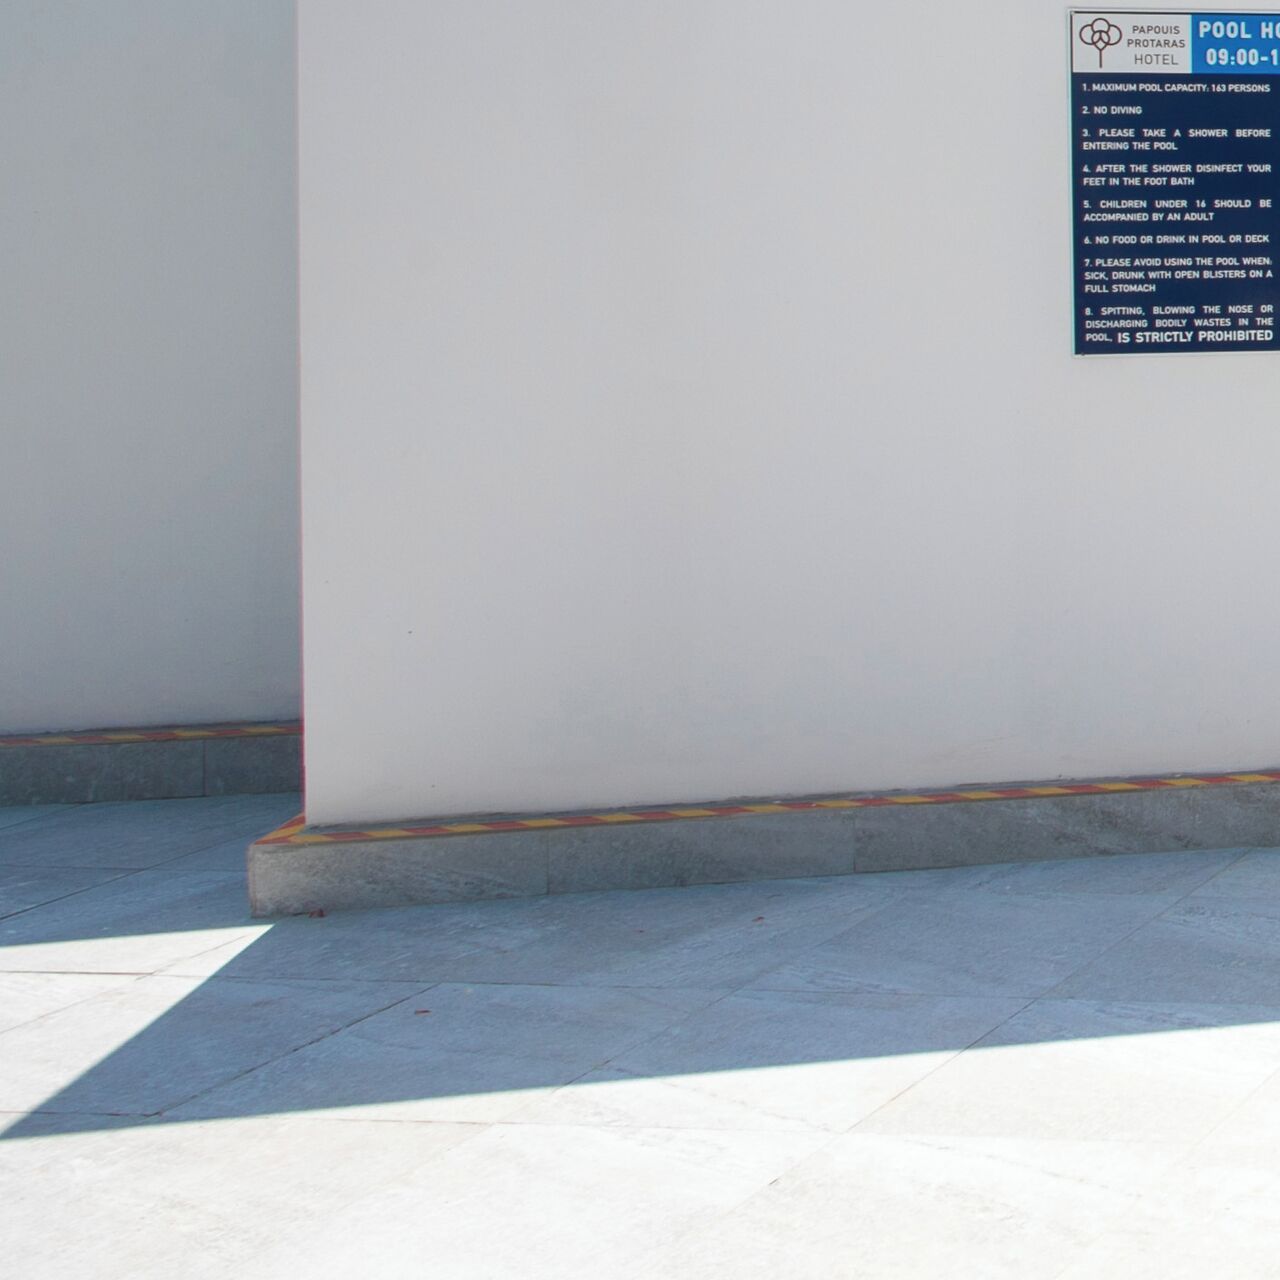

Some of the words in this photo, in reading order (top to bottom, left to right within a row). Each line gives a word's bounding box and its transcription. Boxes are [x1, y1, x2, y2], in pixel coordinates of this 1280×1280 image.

[1132, 25, 1180, 35] PAPOUIS
[1199, 21, 1252, 38] POOL
[1127, 39, 1185, 48] PROTARAS
[1134, 54, 1178, 65] HOTEL
[1083, 83, 1089, 92] 1.
[1092, 83, 1136, 92] MAXIMUM
[1139, 84, 1162, 92] POOL
[1212, 84, 1226, 92] 163
[1228, 84, 1270, 92] PERSONS
[1082, 106, 1090, 114] 2.
[1094, 106, 1108, 114] NO
[1111, 106, 1142, 114] DIVING
[1083, 129, 1090, 137] 3.
[1099, 129, 1135, 137] PLEASE
[1143, 129, 1166, 137] TAKE
[1174, 129, 1181, 137] A
[1189, 129, 1228, 137] SHOWER
[1236, 129, 1271, 137] BEFORE
[1083, 141, 1129, 150] ENTERING
[1133, 141, 1150, 150] THE
[1154, 141, 1177, 150] POOL
[1083, 164, 1091, 173] 4.
[1096, 164, 1125, 173] AFTER
[1130, 164, 1148, 173] THE
[1153, 164, 1191, 173] SHOWER
[1197, 164, 1243, 173] DISINFECT
[1247, 164, 1271, 173] YOUR
[1083, 177, 1106, 186] FEET
[1110, 177, 1119, 186] IN
[1123, 177, 1141, 186] THE
[1144, 177, 1167, 186] FOOT
[1171, 177, 1194, 186] BATH
[1084, 200, 1091, 208] 5.
[1100, 200, 1146, 208] CHILDREN
[1155, 200, 1187, 208] UNDER
[1196, 199, 1206, 208] 16
[1214, 199, 1251, 208] SHOULD
[1260, 199, 1272, 208] BE
[1084, 212, 1149, 221] ACCOMPANIED
[1152, 212, 1164, 221] BY
[1167, 212, 1181, 221] AN
[1184, 212, 1214, 221] ADULT
[1084, 236, 1092, 244] 6.
[1096, 235, 1109, 244] NO
[1112, 235, 1136, 244] FOOD
[1140, 235, 1153, 244] OR
[1156, 235, 1185, 244] DRINK
[1189, 235, 1198, 244] IN
[1202, 235, 1225, 243] POOL
[1229, 235, 1242, 243] OR
[1245, 234, 1269, 243] DECK
[1084, 258, 1092, 267] 7.
[1096, 258, 1131, 267] PLEASE
[1134, 258, 1161, 266] AVOID
[1164, 257, 1192, 266] USING
[1195, 257, 1213, 266] THE
[1216, 257, 1239, 266] POOL
[1085, 271, 1108, 281] SICK,
[1112, 271, 1145, 279] DRUNK
[1148, 271, 1171, 279] WITH
[1174, 270, 1199, 279] OPEN
[1203, 270, 1246, 279] BLISTERS
[1249, 270, 1262, 279] ON
[1265, 270, 1273, 278] A
[1085, 284, 1108, 293] FULL
[1112, 284, 1156, 293] STOMACH
[1085, 306, 1093, 315] 8.
[1101, 306, 1145, 316] SPITTING,
[1153, 306, 1195, 315] BLOWING
[1203, 305, 1221, 314] THE
[1228, 305, 1253, 314] NOSE
[1260, 305, 1273, 313] OR
[1086, 319, 1148, 328] DISCHARGING
[1156, 319, 1187, 328] BODILY
[1194, 318, 1231, 327] WASTES
[1239, 318, 1248, 327] IN
[1256, 318, 1273, 326] THE
[1118, 332, 1130, 343] IS
[1136, 332, 1192, 343] STRICTLY
[1198, 330, 1273, 342] PROHIBITED
